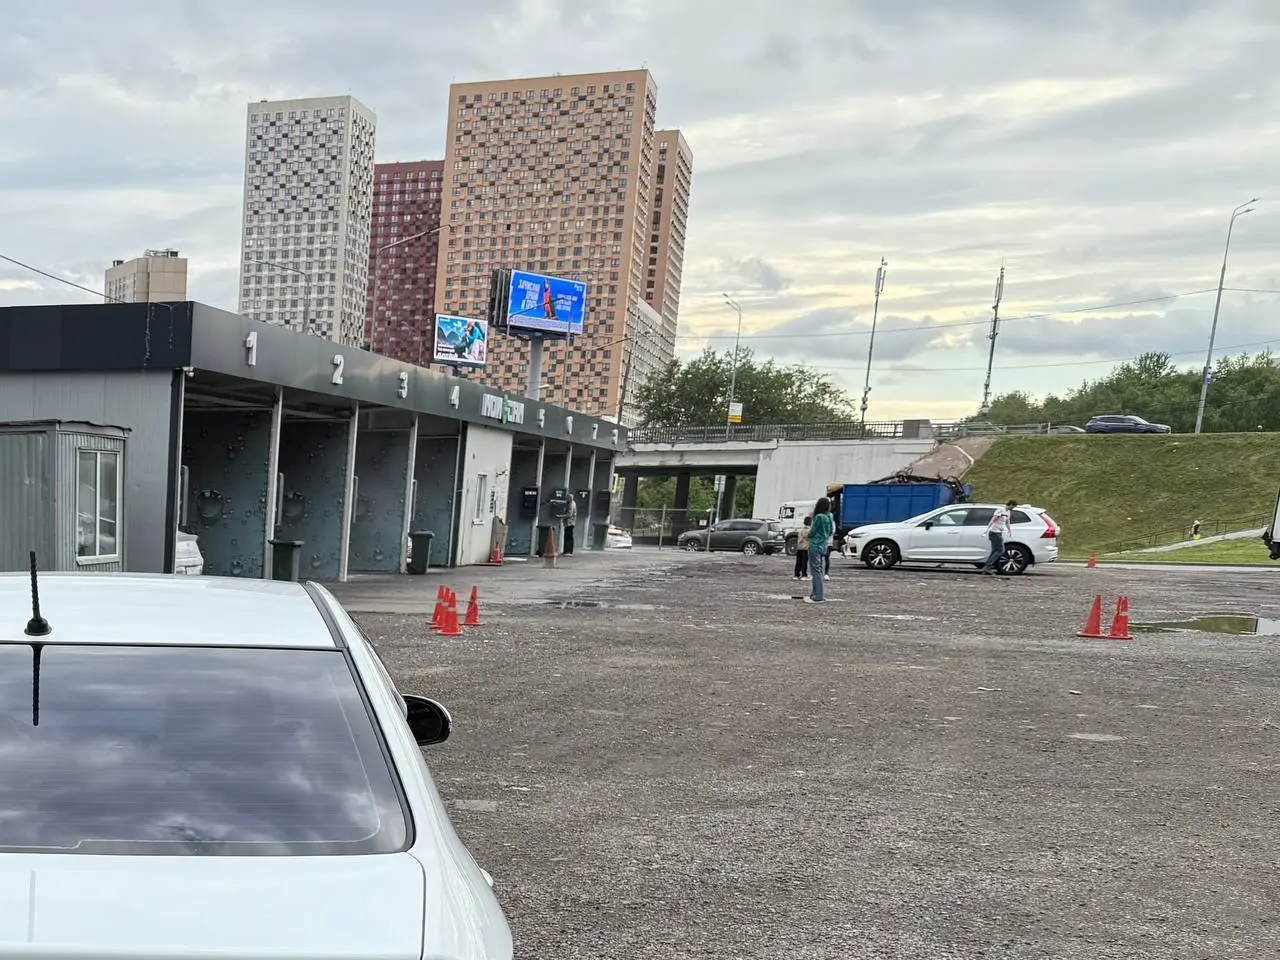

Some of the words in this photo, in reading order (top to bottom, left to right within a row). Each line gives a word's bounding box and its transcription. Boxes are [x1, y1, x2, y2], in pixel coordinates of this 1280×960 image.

[246, 331, 258, 366] 1
[332, 354, 345, 385] 2
[399, 371, 409, 399] 3
[449, 385, 460, 410] 4
